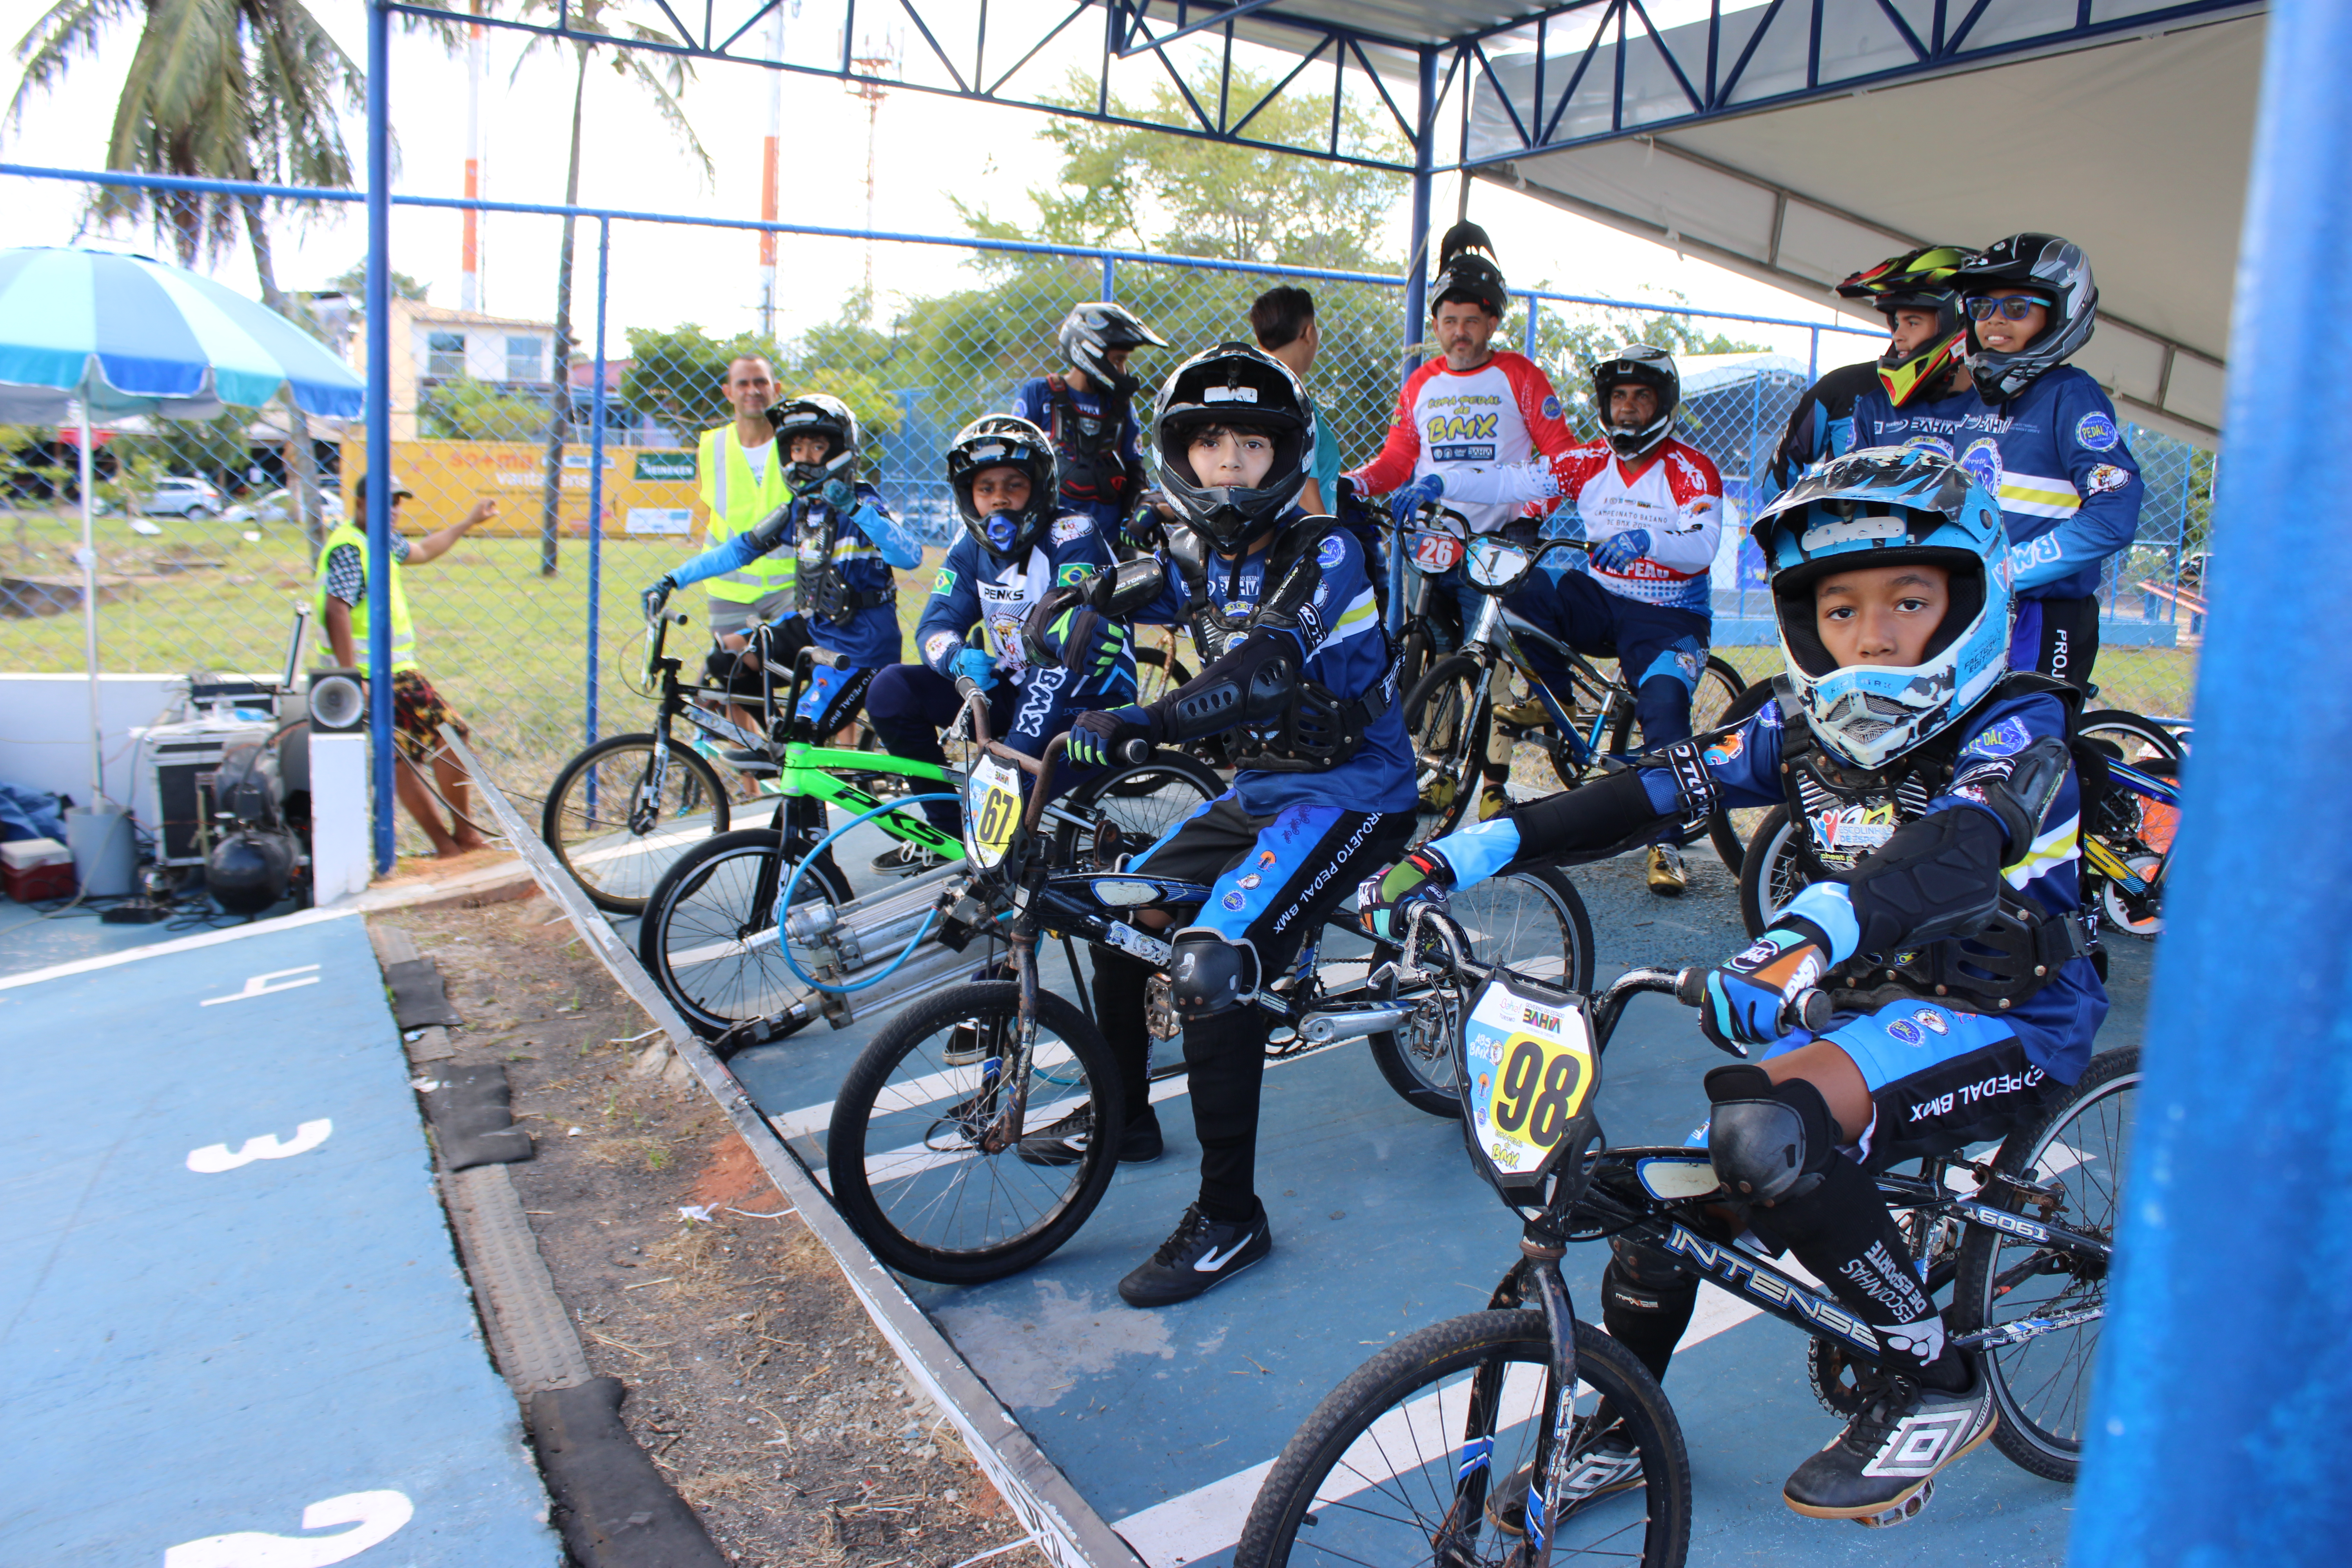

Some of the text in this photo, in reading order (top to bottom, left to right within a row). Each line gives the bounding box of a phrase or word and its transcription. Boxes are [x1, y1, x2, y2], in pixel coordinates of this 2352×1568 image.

[1428, 395, 1502, 409] COPA PEDAL
[1454, 405, 1470, 415] de
[1428, 413, 1499, 443] BMX
[1910, 422, 1956, 435] BAHIA
[2082, 425, 2107, 440] PEDAL
[1964, 457, 1986, 469] Projeto
[495, 472, 590, 488] vantaens
[1594, 510, 1668, 523] CAMPEONATO BAIANO
[1419, 537, 1454, 566] 26
[1487, 550, 1502, 573] 1
[2011, 531, 2062, 575] BM
[984, 588, 1024, 601] PENKS
[1115, 582, 1126, 591] RO
[1126, 573, 1147, 585] TORK
[1318, 590, 1330, 608] Salvador
[2051, 629, 2069, 681] PROJ
[839, 685, 863, 709] PEDAL
[1016, 667, 1067, 738] BMX
[979, 788, 1014, 848] 67
[1820, 852, 1846, 861] chest
[1299, 861, 1339, 902] PEDAL
[1273, 903, 1299, 935] BMX
[1499, 998, 1522, 1014] Bahia!
[1526, 1002, 1543, 1014] GOVERNO
[1550, 1008, 1565, 1019] ESTADO
[1499, 1008, 1563, 1034] TURISMO BAHIA
[1475, 1033, 1491, 1047] ABS
[1891, 1020, 1913, 1036] PEDAL
[1469, 1041, 1489, 1060] BMX
[1497, 1041, 1581, 1147] 98
[1958, 1071, 2022, 1105] PEDAL
[1909, 1092, 1955, 1123] BMX
[1495, 1129, 1524, 1148] COPA PEDAL
[1491, 1143, 1520, 1171] BMX
[1976, 1206, 2051, 1243] 6061
[1663, 1221, 1880, 1357] INTENSE
[1864, 1239, 1928, 1314] DE ESPORTE
[1838, 1259, 1916, 1325] ESCOLINHAS
[1976, 1388, 1991, 1428] umbro
